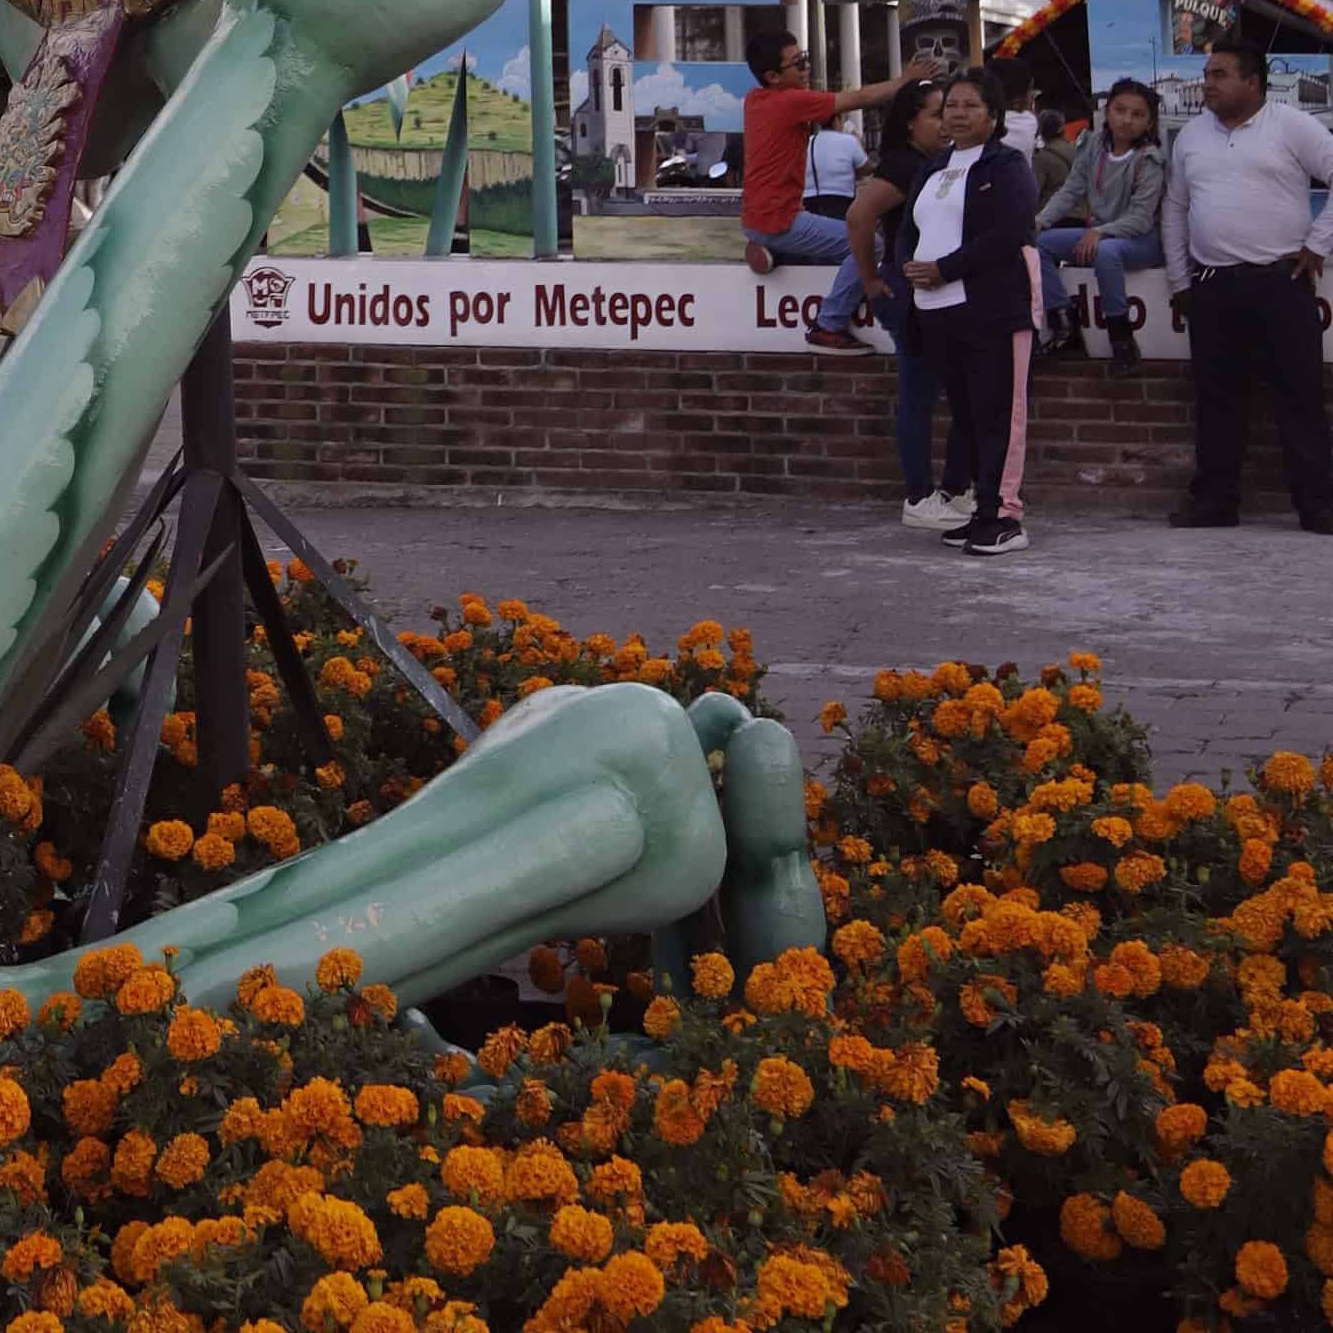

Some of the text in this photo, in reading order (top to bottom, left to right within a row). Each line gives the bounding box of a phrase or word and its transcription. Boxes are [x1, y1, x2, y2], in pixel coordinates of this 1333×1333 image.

[308, 283, 429, 327] Unidos
[449, 290, 511, 337] por
[534, 284, 695, 340] Metepec
